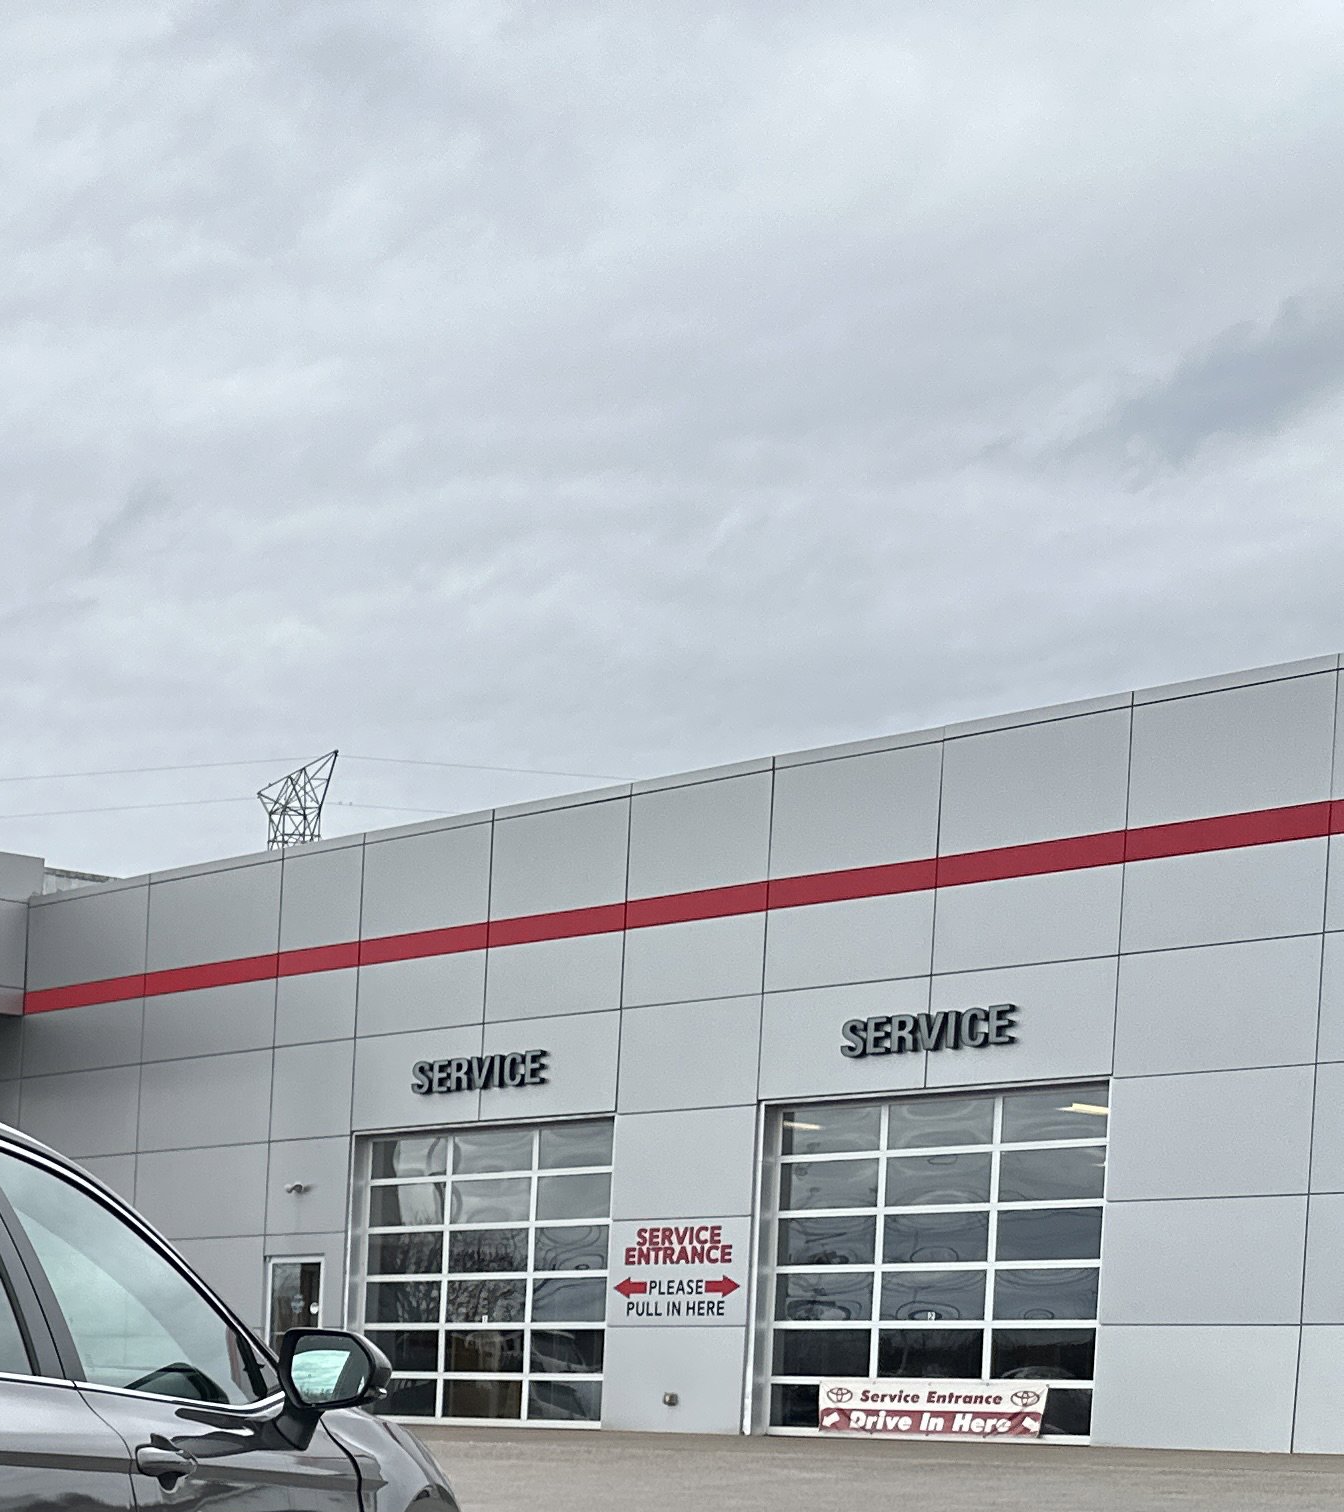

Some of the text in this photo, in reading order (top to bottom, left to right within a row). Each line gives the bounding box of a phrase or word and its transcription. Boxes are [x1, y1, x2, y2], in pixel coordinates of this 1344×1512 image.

[840, 1003, 1017, 1059] SERVICE
[411, 1049, 548, 1095] SERVICE
[636, 1225, 723, 1247] SERVICE
[624, 1244, 733, 1266] ENTRANCE
[648, 1279, 704, 1296] PLEASE
[626, 1300, 725, 1317] PULL IN HERE
[860, 1389, 1004, 1406] Service Entrance
[849, 1410, 1012, 1434] Drive In Here
